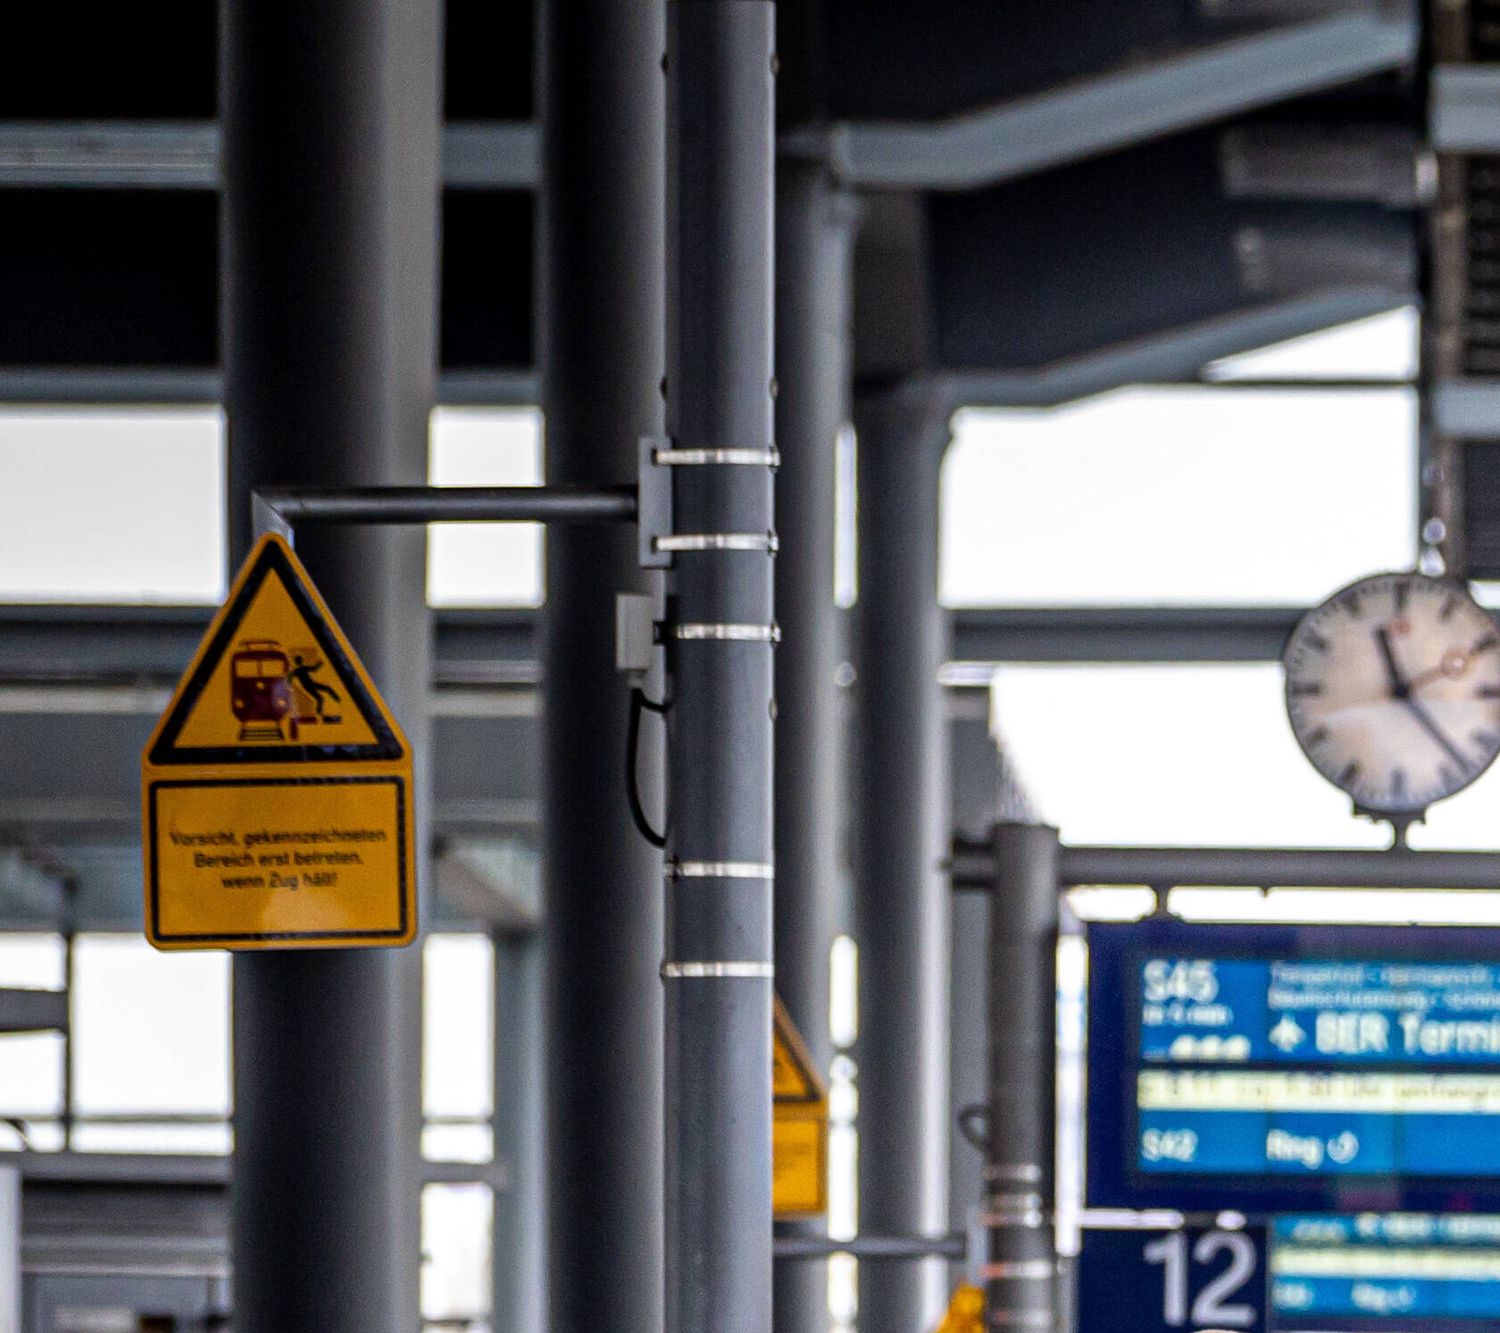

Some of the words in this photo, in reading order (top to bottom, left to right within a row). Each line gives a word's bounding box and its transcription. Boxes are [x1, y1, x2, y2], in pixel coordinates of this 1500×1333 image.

[194, 852, 255, 868] Bereich
[259, 852, 289, 866] erst
[222, 876, 264, 889] wenn
[1144, 959, 1218, 1001] S45
[1316, 1011, 1389, 1053] BER
[1144, 1229, 1256, 1328] 12
